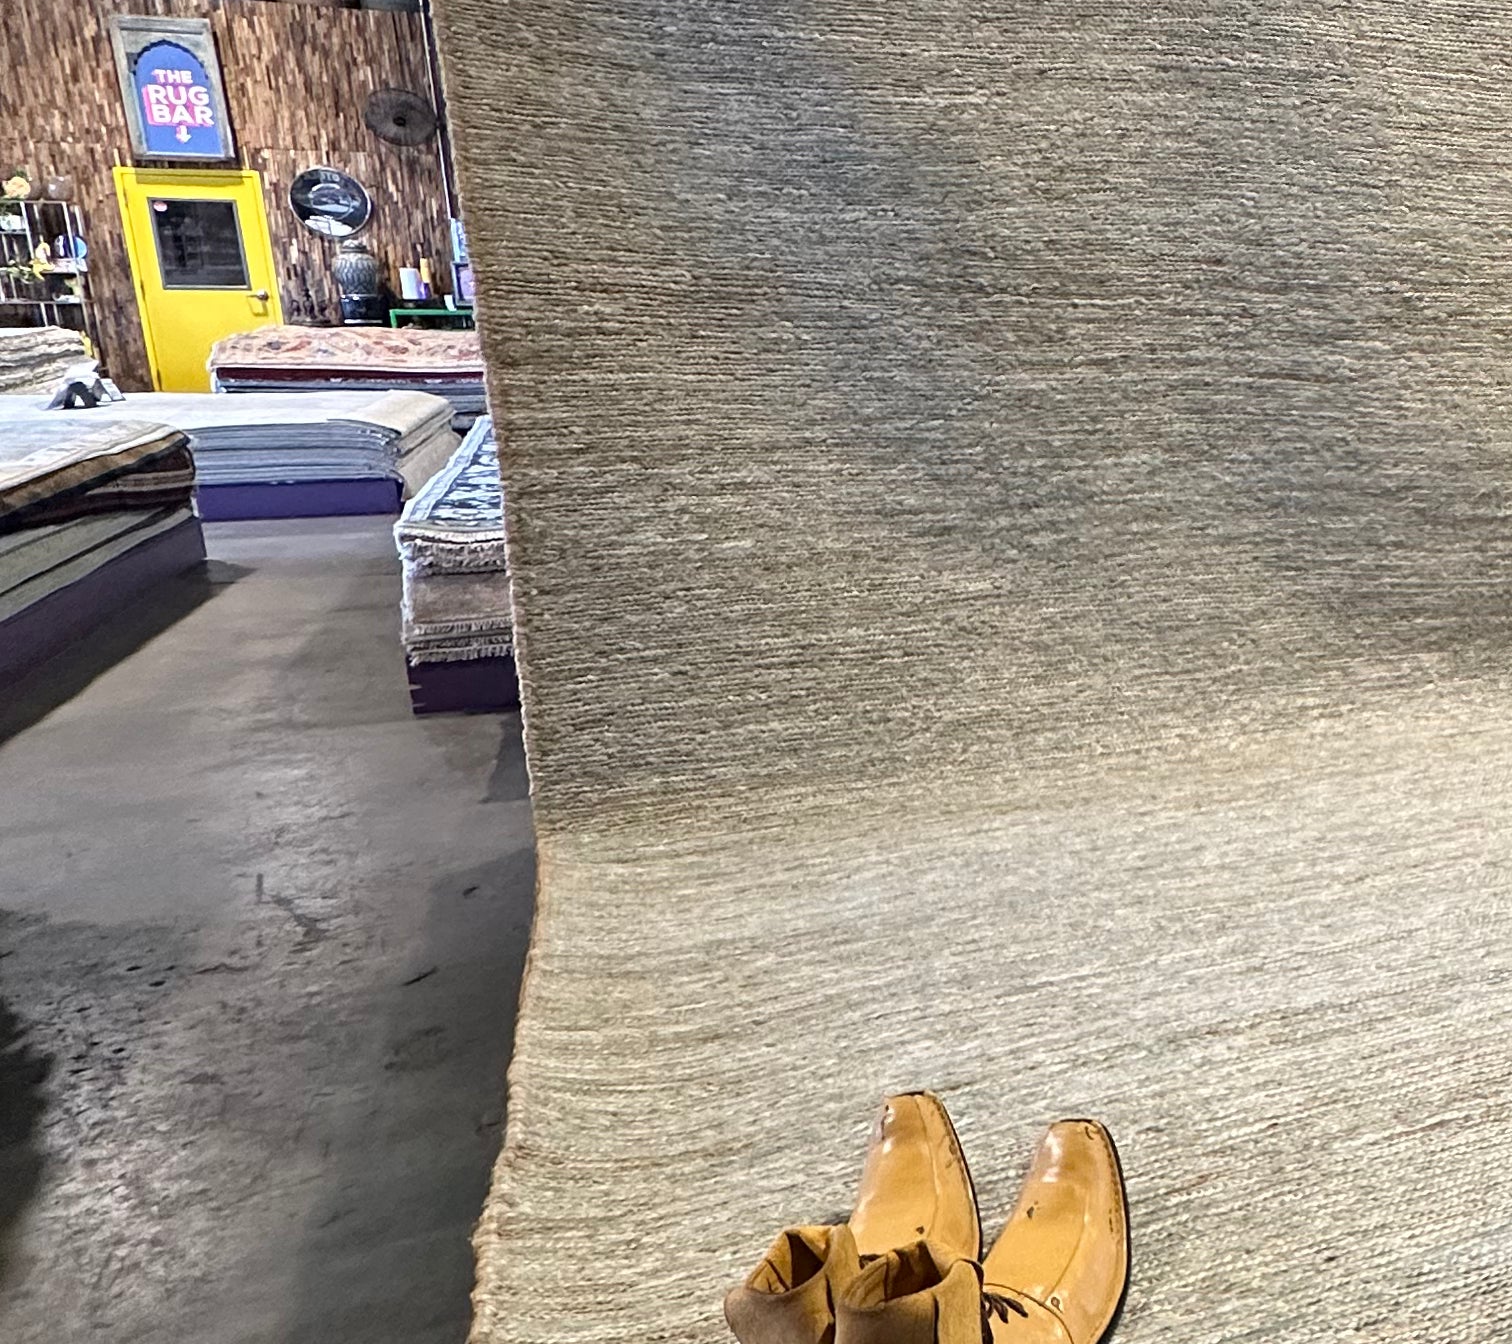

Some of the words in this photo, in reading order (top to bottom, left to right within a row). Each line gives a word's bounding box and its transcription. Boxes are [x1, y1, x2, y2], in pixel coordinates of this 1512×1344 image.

[153, 69, 194, 84] THE
[146, 84, 210, 106] RUG
[150, 104, 215, 125] BAR
